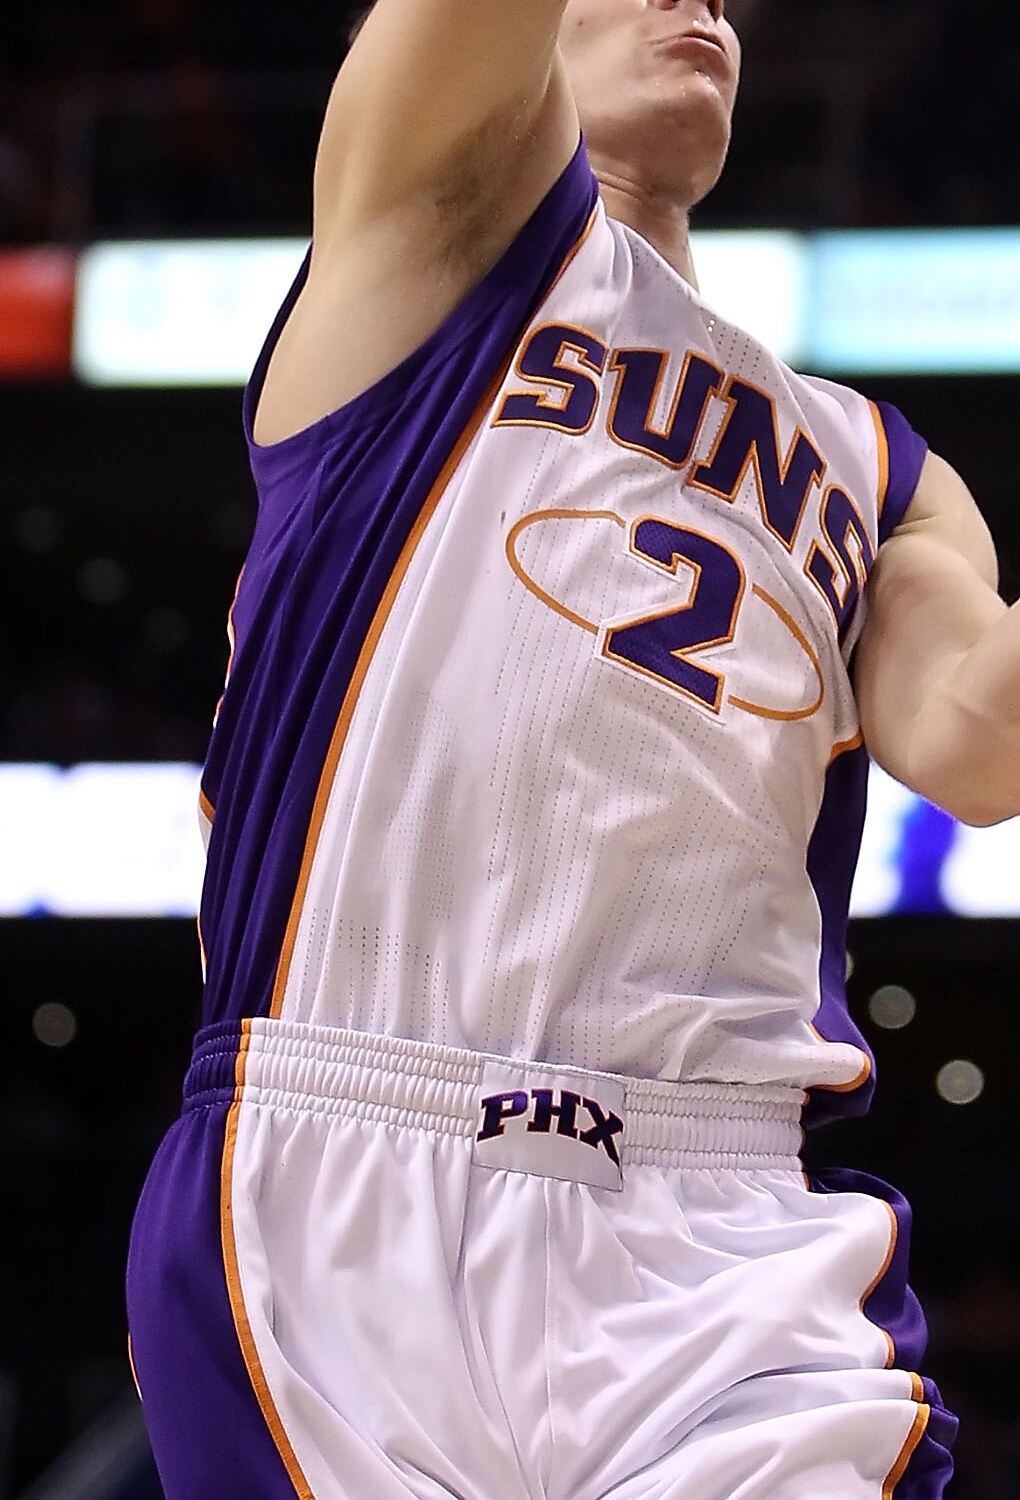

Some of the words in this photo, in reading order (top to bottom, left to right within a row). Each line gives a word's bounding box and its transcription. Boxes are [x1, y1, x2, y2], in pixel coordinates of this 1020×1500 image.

[490, 319, 876, 650] SUNS
[598, 513, 747, 716] 2
[475, 1086, 624, 1172] PHX
